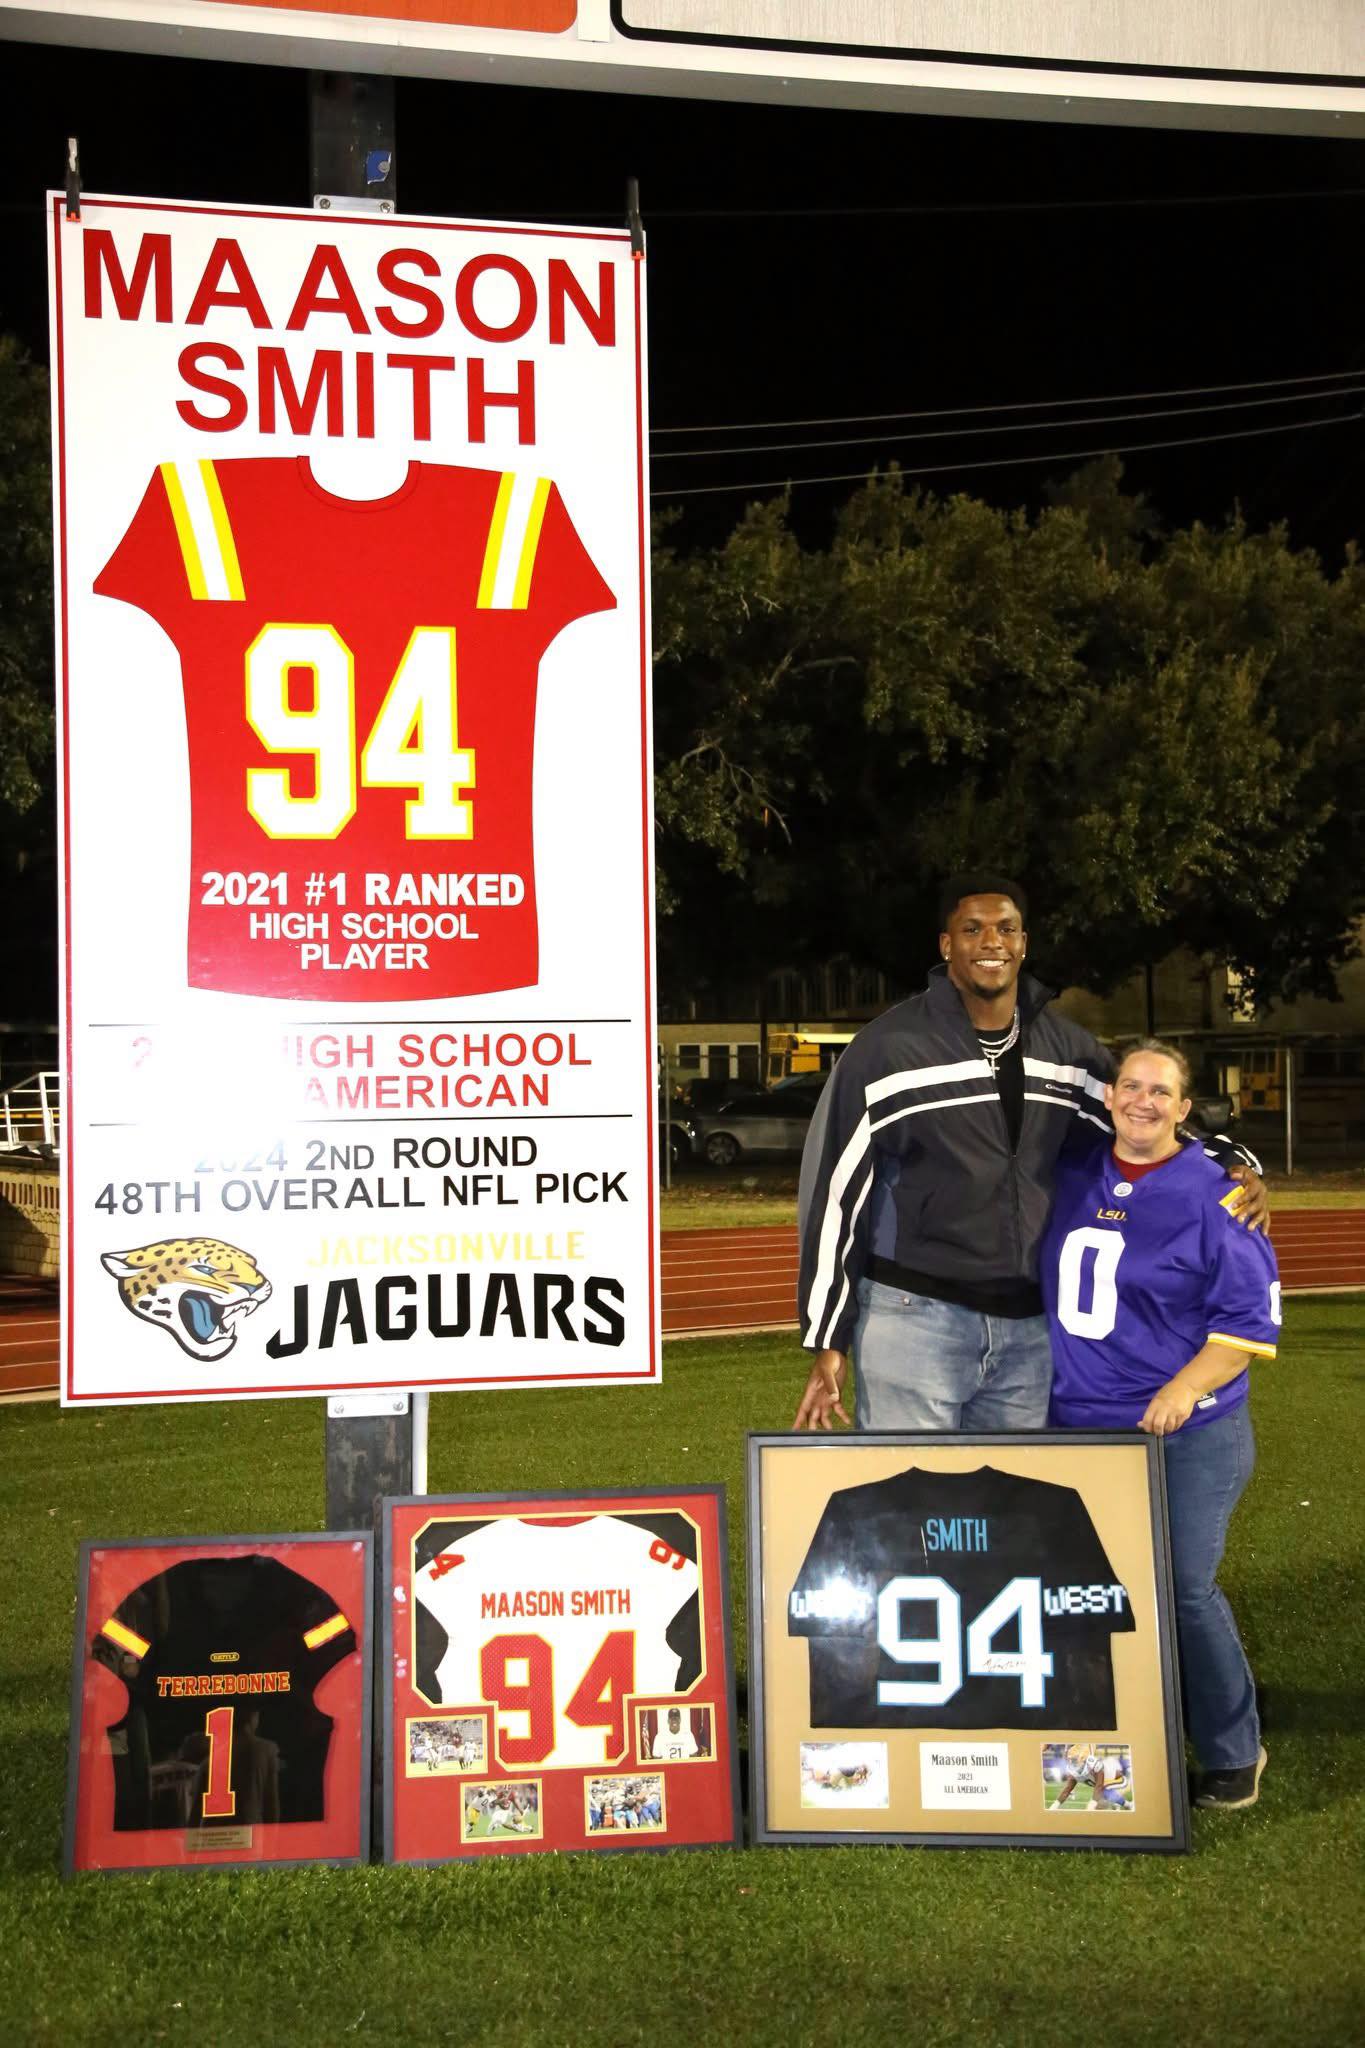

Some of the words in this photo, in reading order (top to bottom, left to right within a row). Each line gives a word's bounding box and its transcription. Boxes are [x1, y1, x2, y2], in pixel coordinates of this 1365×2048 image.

[84, 229, 616, 347] MAASON
[175, 342, 537, 446] SMITH
[245, 622, 477, 841] 94
[201, 873, 289, 906] 2021
[304, 873, 347, 906] #1
[365, 873, 526, 907] RANKED
[249, 913, 329, 941] HIGH
[341, 913, 480, 941] SCHOOL
[300, 944, 430, 971] PLAYER
[398, 1033, 593, 1069] SCHOOL
[304, 1074, 550, 1111] AMERICAN
[305, 1140, 375, 1171] 2ND
[393, 1136, 539, 1170] ROUND
[95, 1181, 202, 1216] 48TH
[220, 1176, 426, 1213] OVERALL
[443, 1176, 519, 1207] NFL
[535, 1171, 630, 1205] PICK
[1096, 1208, 1127, 1221] LSU
[305, 1230, 586, 1269] JACKSONVILLE
[1057, 1226, 1126, 1340] 0
[265, 1273, 625, 1359] JAGUARS
[925, 1518, 988, 1554] SMITH
[481, 1593, 566, 1619] MAASON
[571, 1589, 631, 1617] SMITH
[1043, 1584, 1128, 1617] WEST
[877, 1576, 1054, 1708] 94
[157, 1671, 291, 1697] TERREBONNE
[480, 1629, 636, 1765] 94
[202, 1706, 236, 1818] 1
[931, 1753, 968, 1766] Maason
[971, 1755, 999, 1767] Smith
